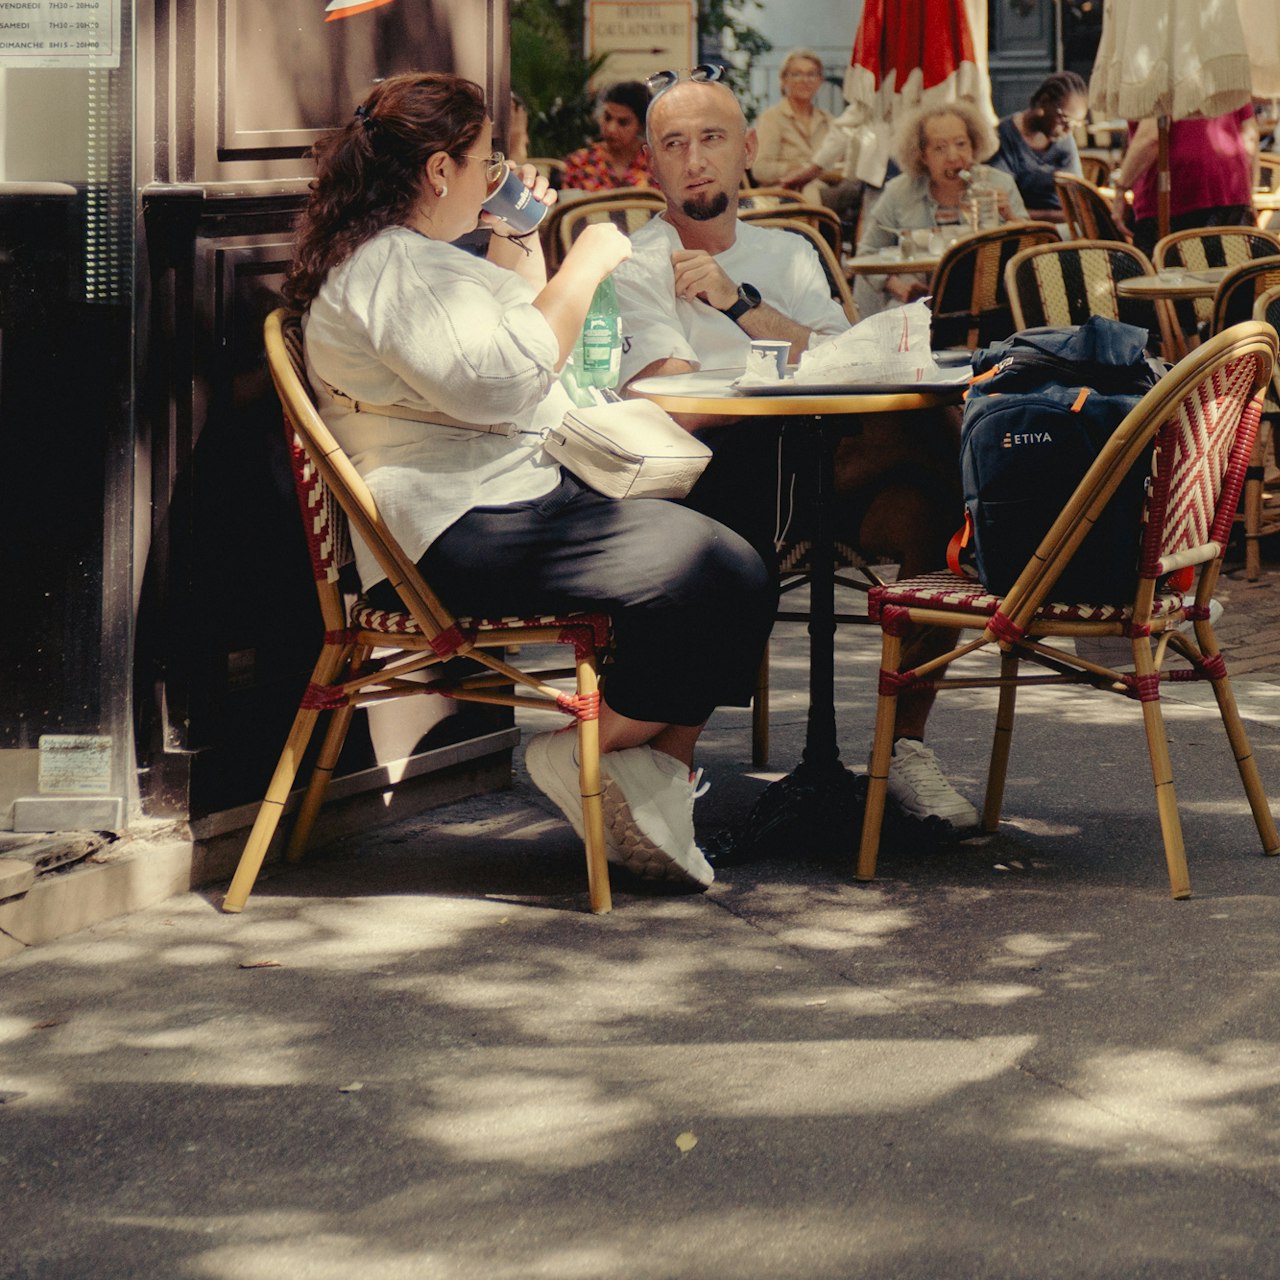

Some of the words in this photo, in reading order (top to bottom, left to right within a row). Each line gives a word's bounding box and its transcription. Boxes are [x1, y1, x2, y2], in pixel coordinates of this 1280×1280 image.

[0, 2, 40, 10] VENDREDI
[0, 22, 30, 30] SAMEDI
[0, 41, 44, 49] DIMANCHE
[1014, 432, 1052, 445] ETIYA
